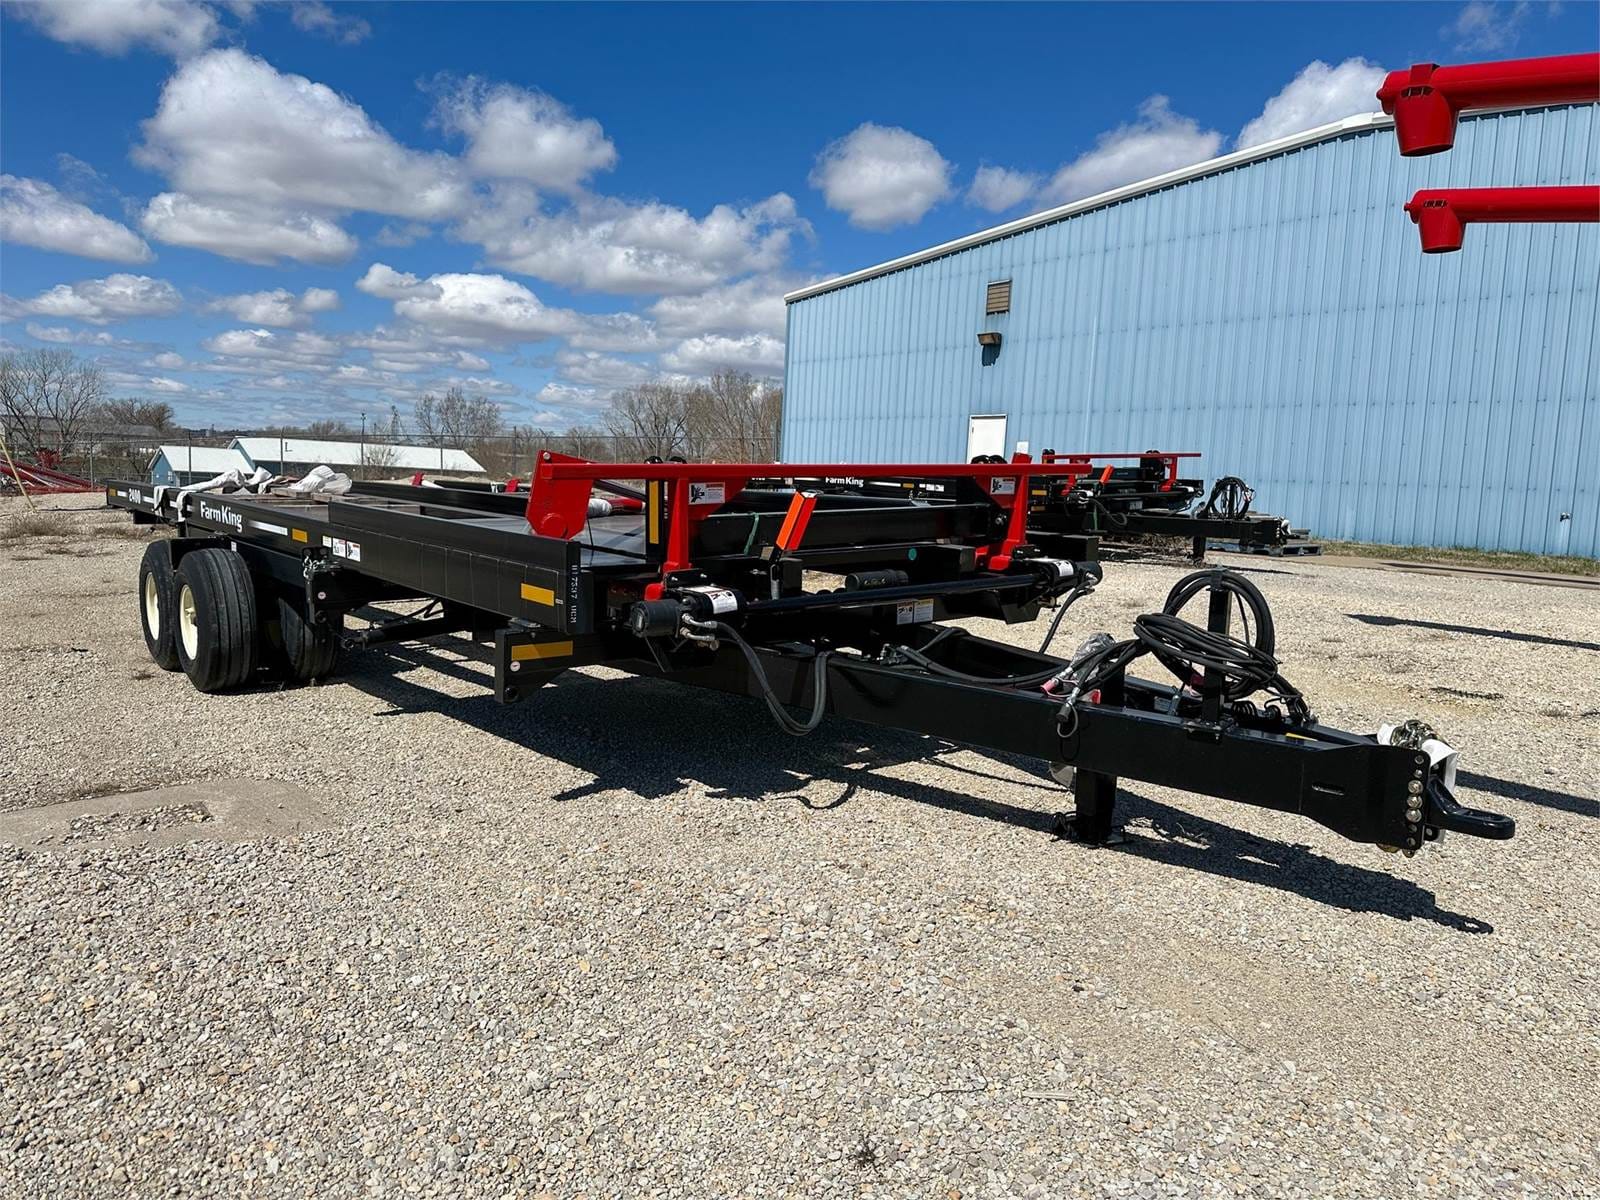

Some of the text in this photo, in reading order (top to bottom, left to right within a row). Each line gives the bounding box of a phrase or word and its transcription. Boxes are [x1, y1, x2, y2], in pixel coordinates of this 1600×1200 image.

[845, 476, 864, 488] King
[200, 501, 243, 533] Farm King
